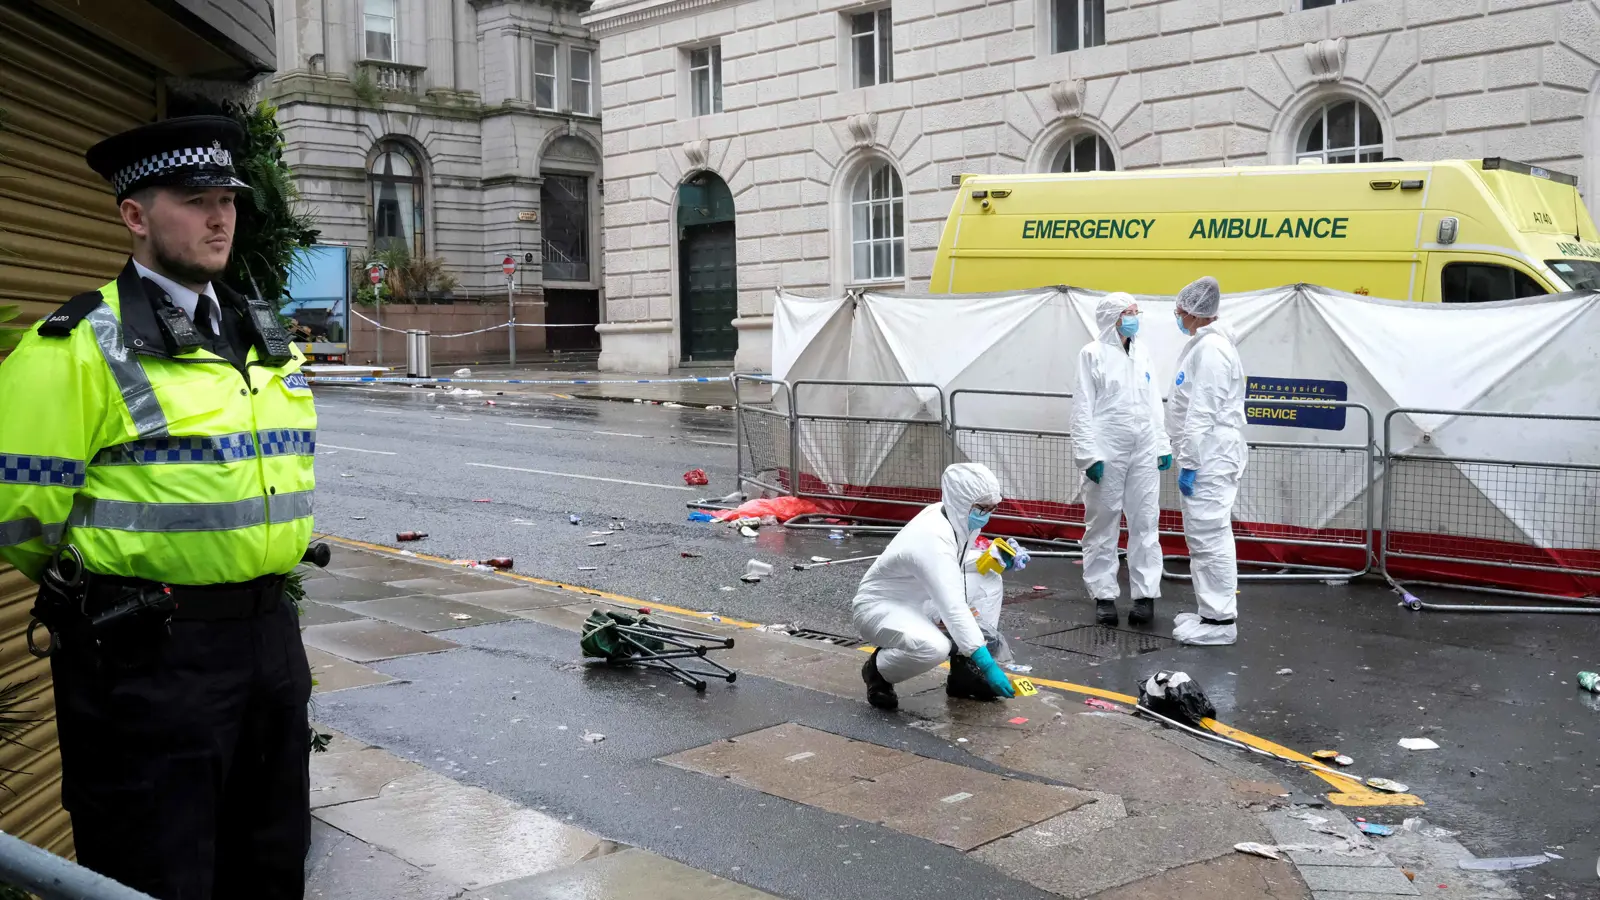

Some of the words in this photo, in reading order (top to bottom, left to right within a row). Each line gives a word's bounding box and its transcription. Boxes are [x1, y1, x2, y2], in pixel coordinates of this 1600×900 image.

[1533, 211, 1553, 225] A740
[1022, 218, 1156, 239] EMERGENCY
[1188, 217, 1349, 239] AMBULANCE
[1249, 382, 1325, 394] Merseyside
[1247, 407, 1297, 420] SERVICE
[1018, 680, 1034, 693] 13
